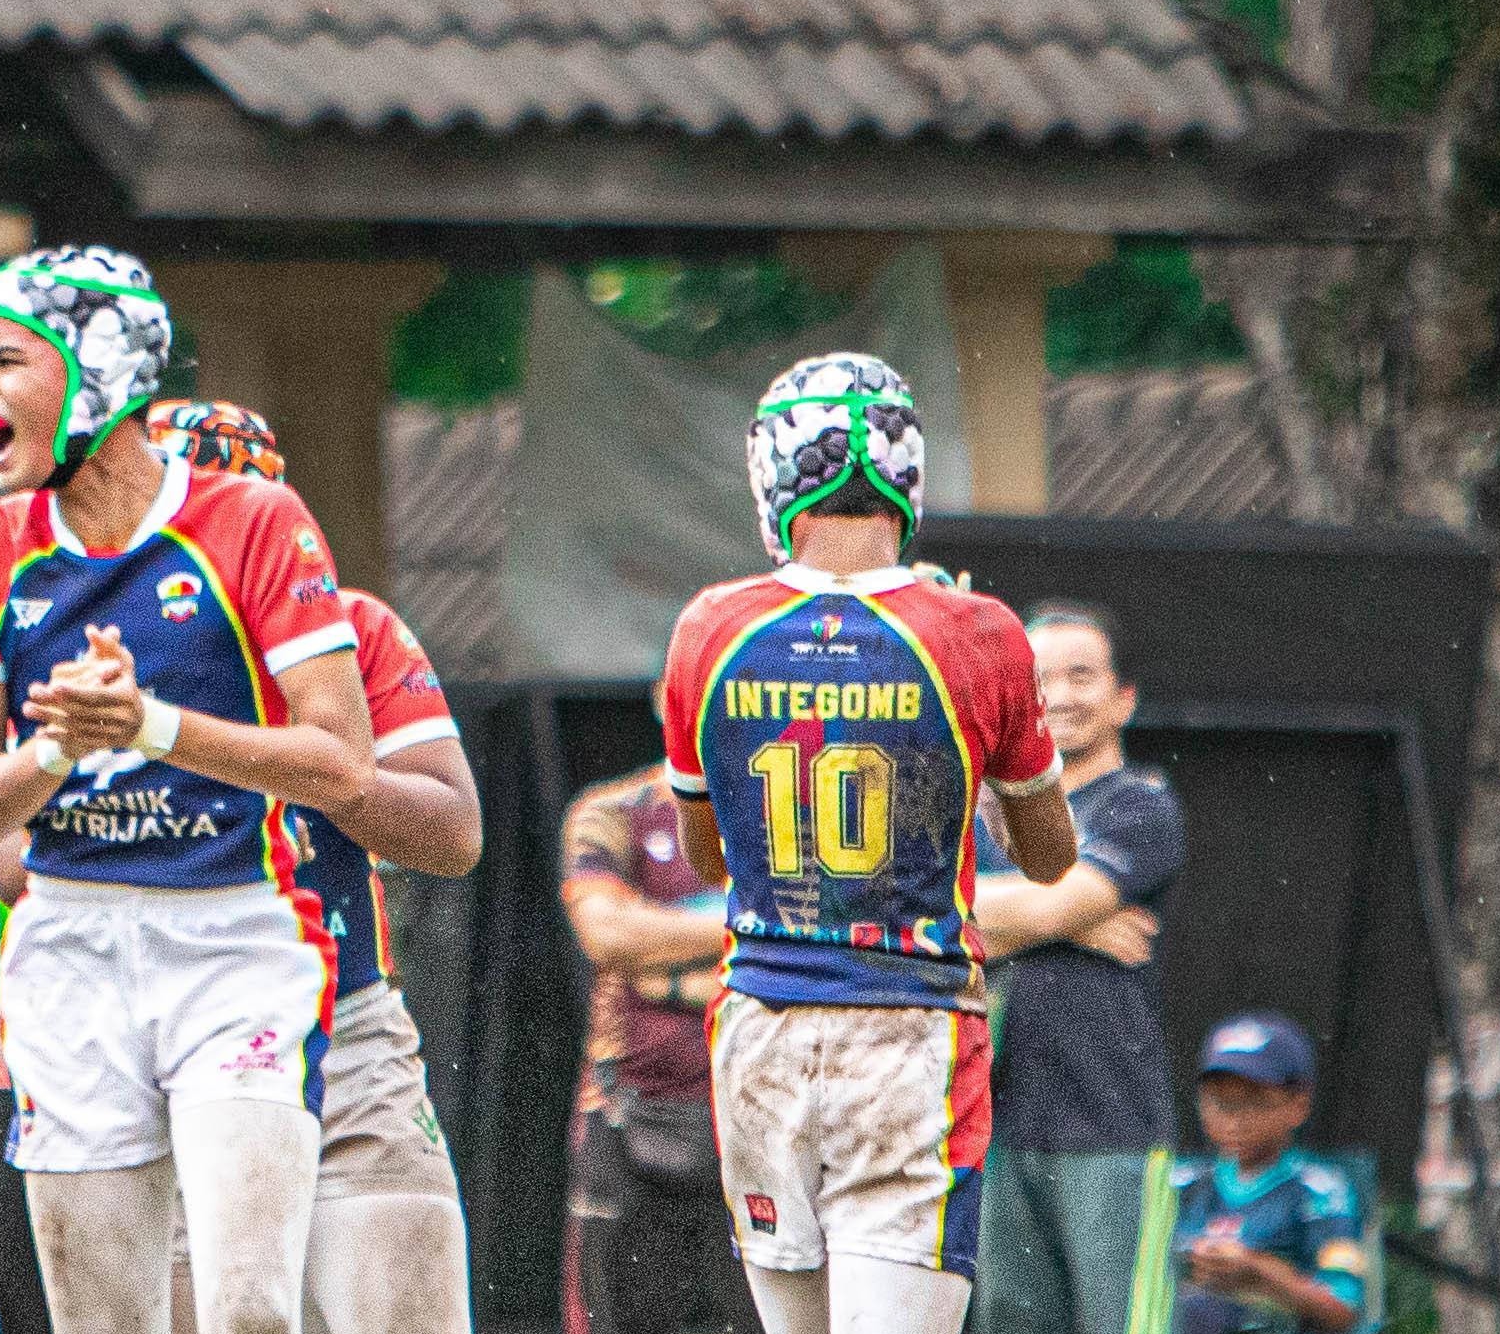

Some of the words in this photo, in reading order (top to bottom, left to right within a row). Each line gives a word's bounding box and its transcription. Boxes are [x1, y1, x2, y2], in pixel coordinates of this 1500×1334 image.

[724, 680, 921, 720] INTEGOMB
[46, 809, 219, 843] UTRIJAYA
[748, 742, 898, 879] 10
